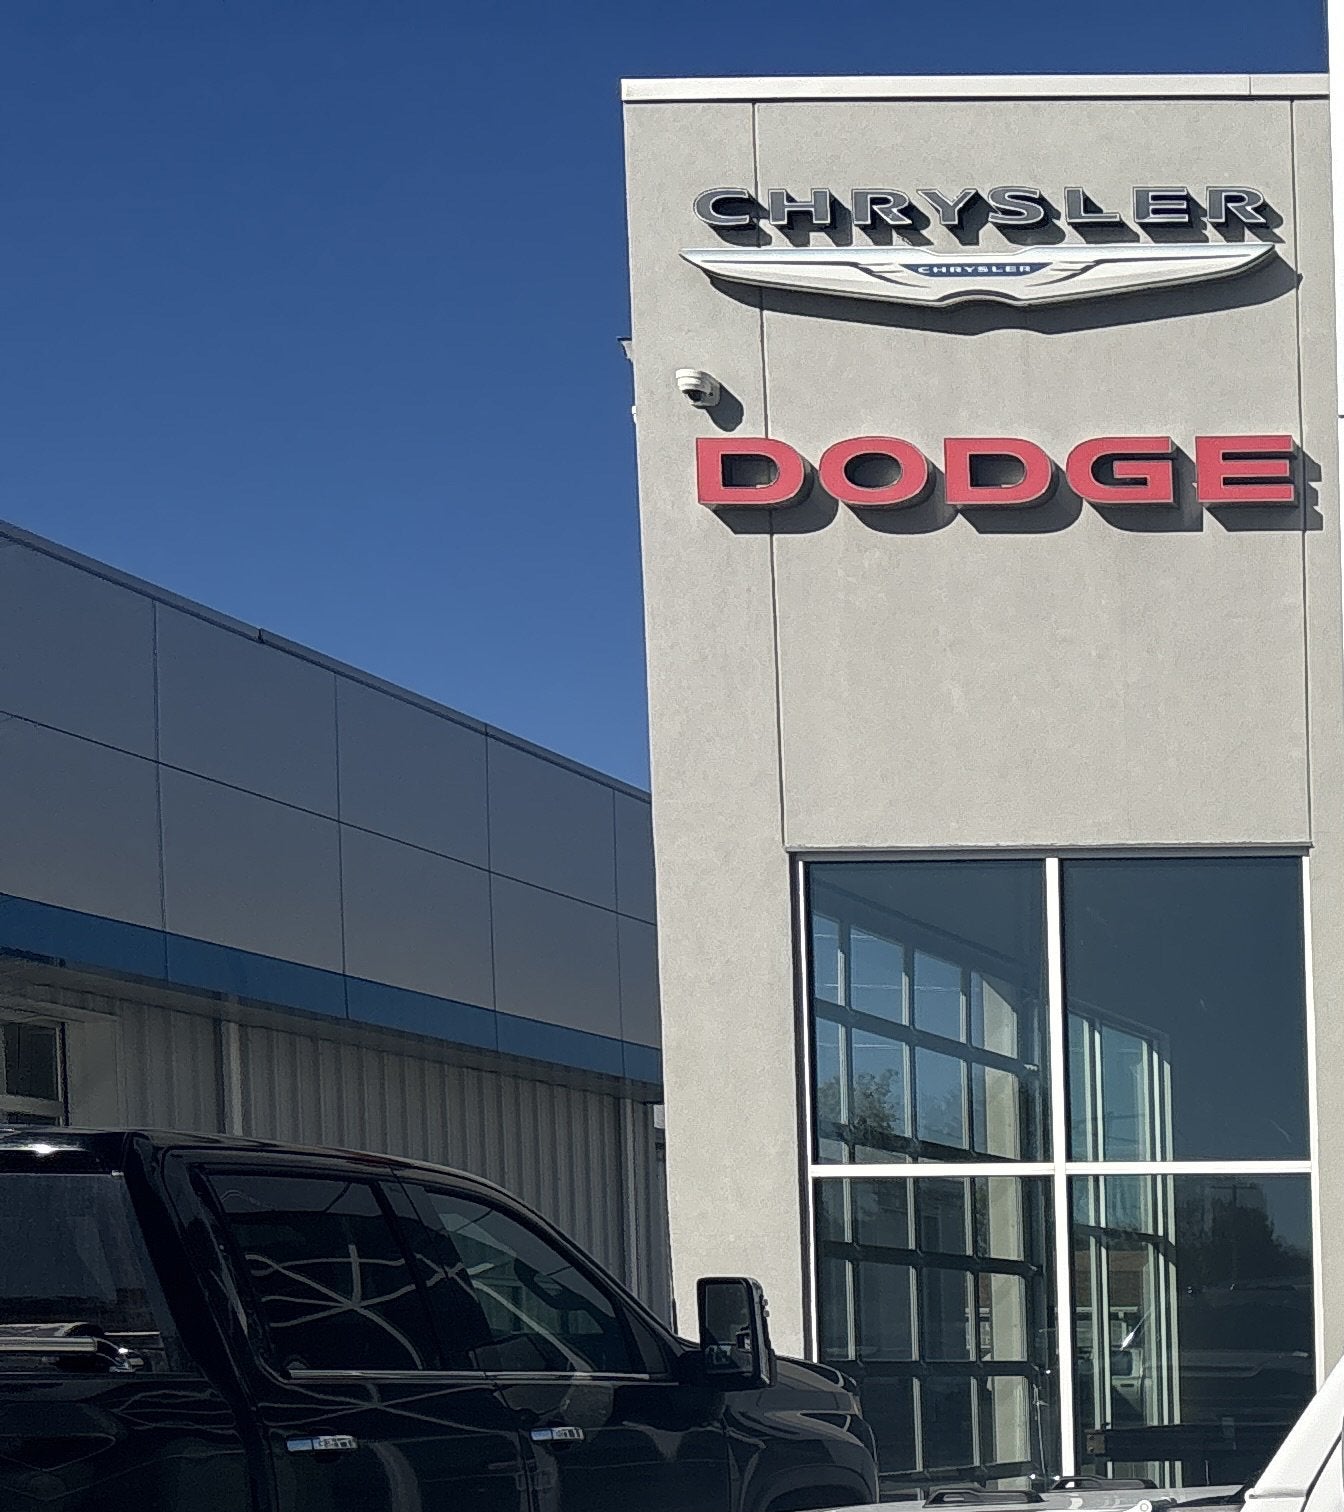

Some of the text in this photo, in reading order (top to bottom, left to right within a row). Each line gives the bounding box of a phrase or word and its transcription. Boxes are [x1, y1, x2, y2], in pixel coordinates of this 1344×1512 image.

[692, 185, 1268, 230] CHRYSLER
[916, 264, 1033, 275] CHRYSLER
[695, 435, 1298, 508] DODGE
